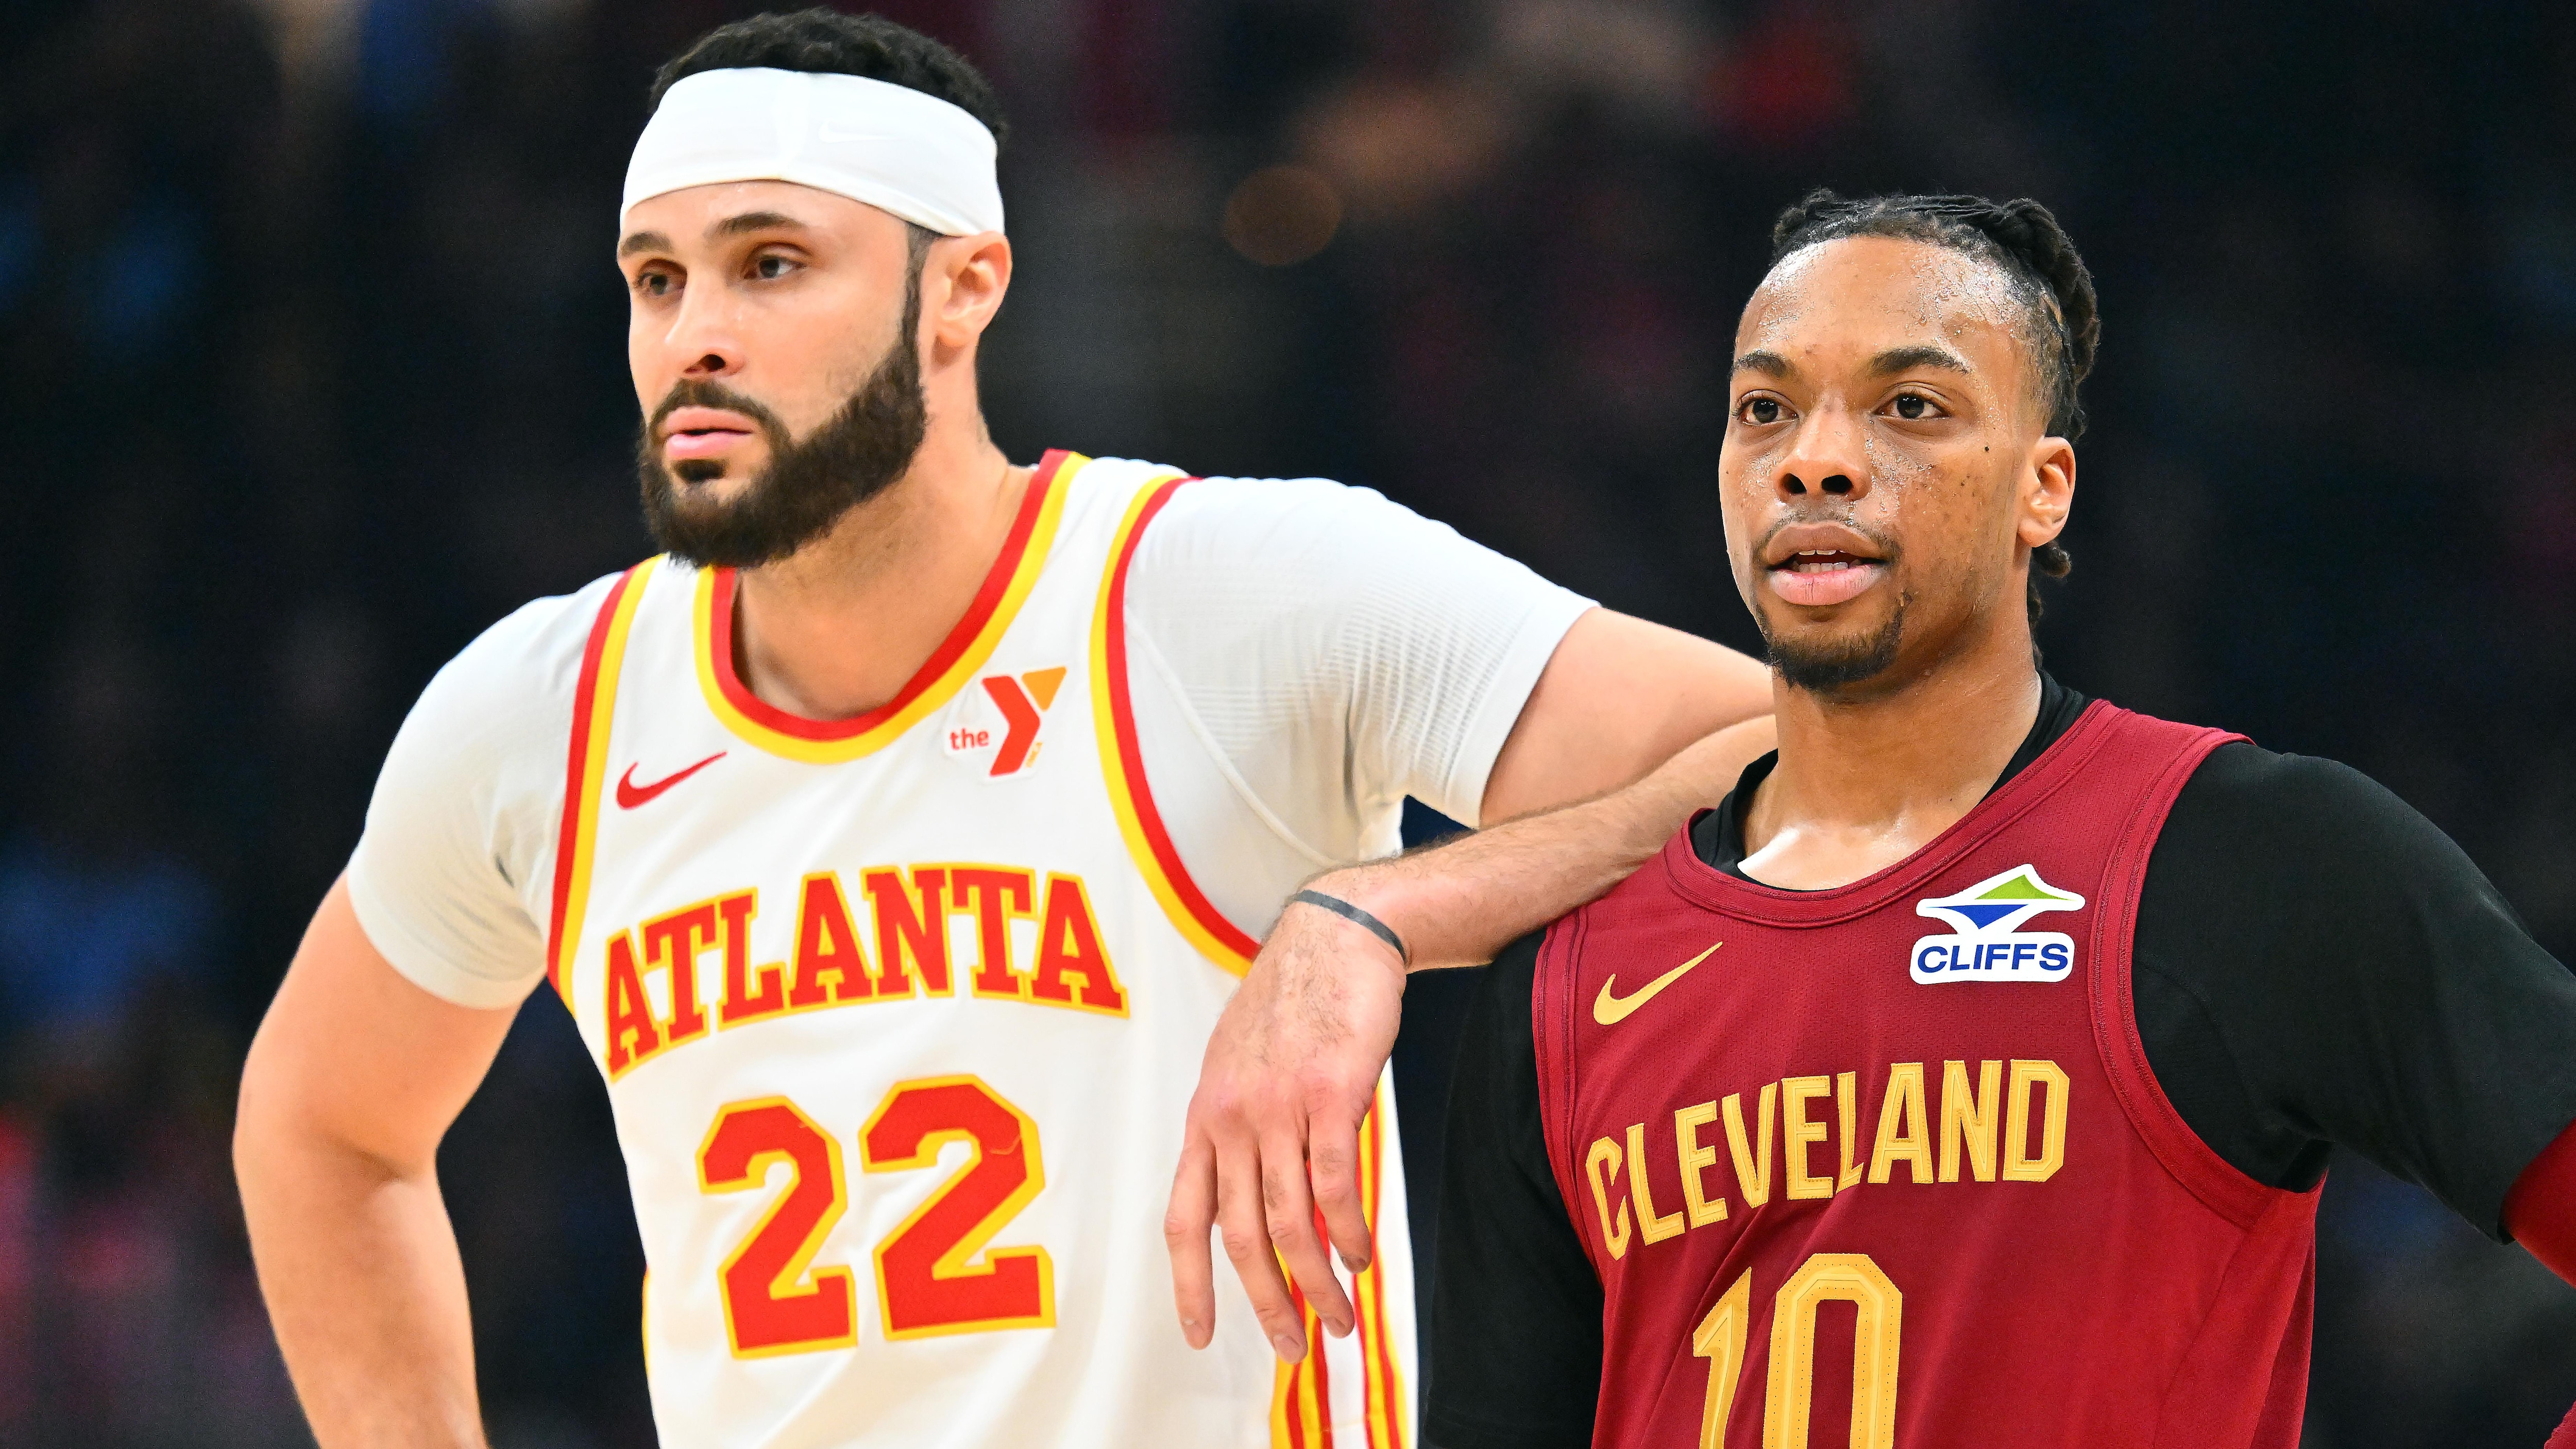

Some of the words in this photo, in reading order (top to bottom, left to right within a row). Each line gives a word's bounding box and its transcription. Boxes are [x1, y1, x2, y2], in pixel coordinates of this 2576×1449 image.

[950, 728, 989, 750] the
[604, 862, 1129, 1083] ATLANTA
[1918, 943, 2068, 973] CLIFFS
[695, 1074, 1056, 1359] 22
[1585, 1059, 2070, 1260] CLEVELAND
[1692, 1253, 1903, 1449] 10
